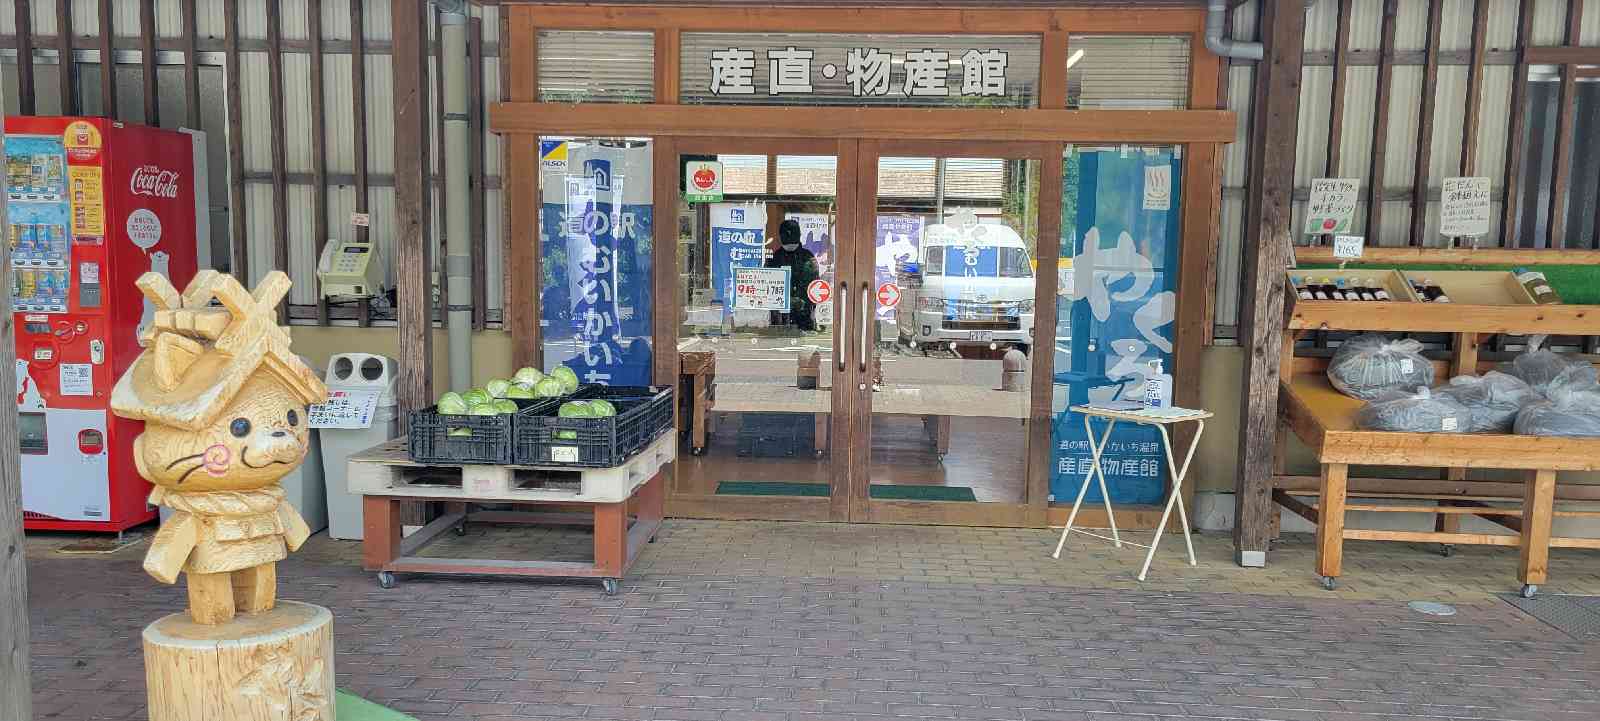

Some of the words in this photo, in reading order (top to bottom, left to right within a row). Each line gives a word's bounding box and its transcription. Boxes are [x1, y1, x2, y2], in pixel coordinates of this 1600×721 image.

[709, 46, 1009, 98] 産直・物産館
[542, 160, 567, 168] ALSOK
[130, 167, 179, 198] Coca-Cola
